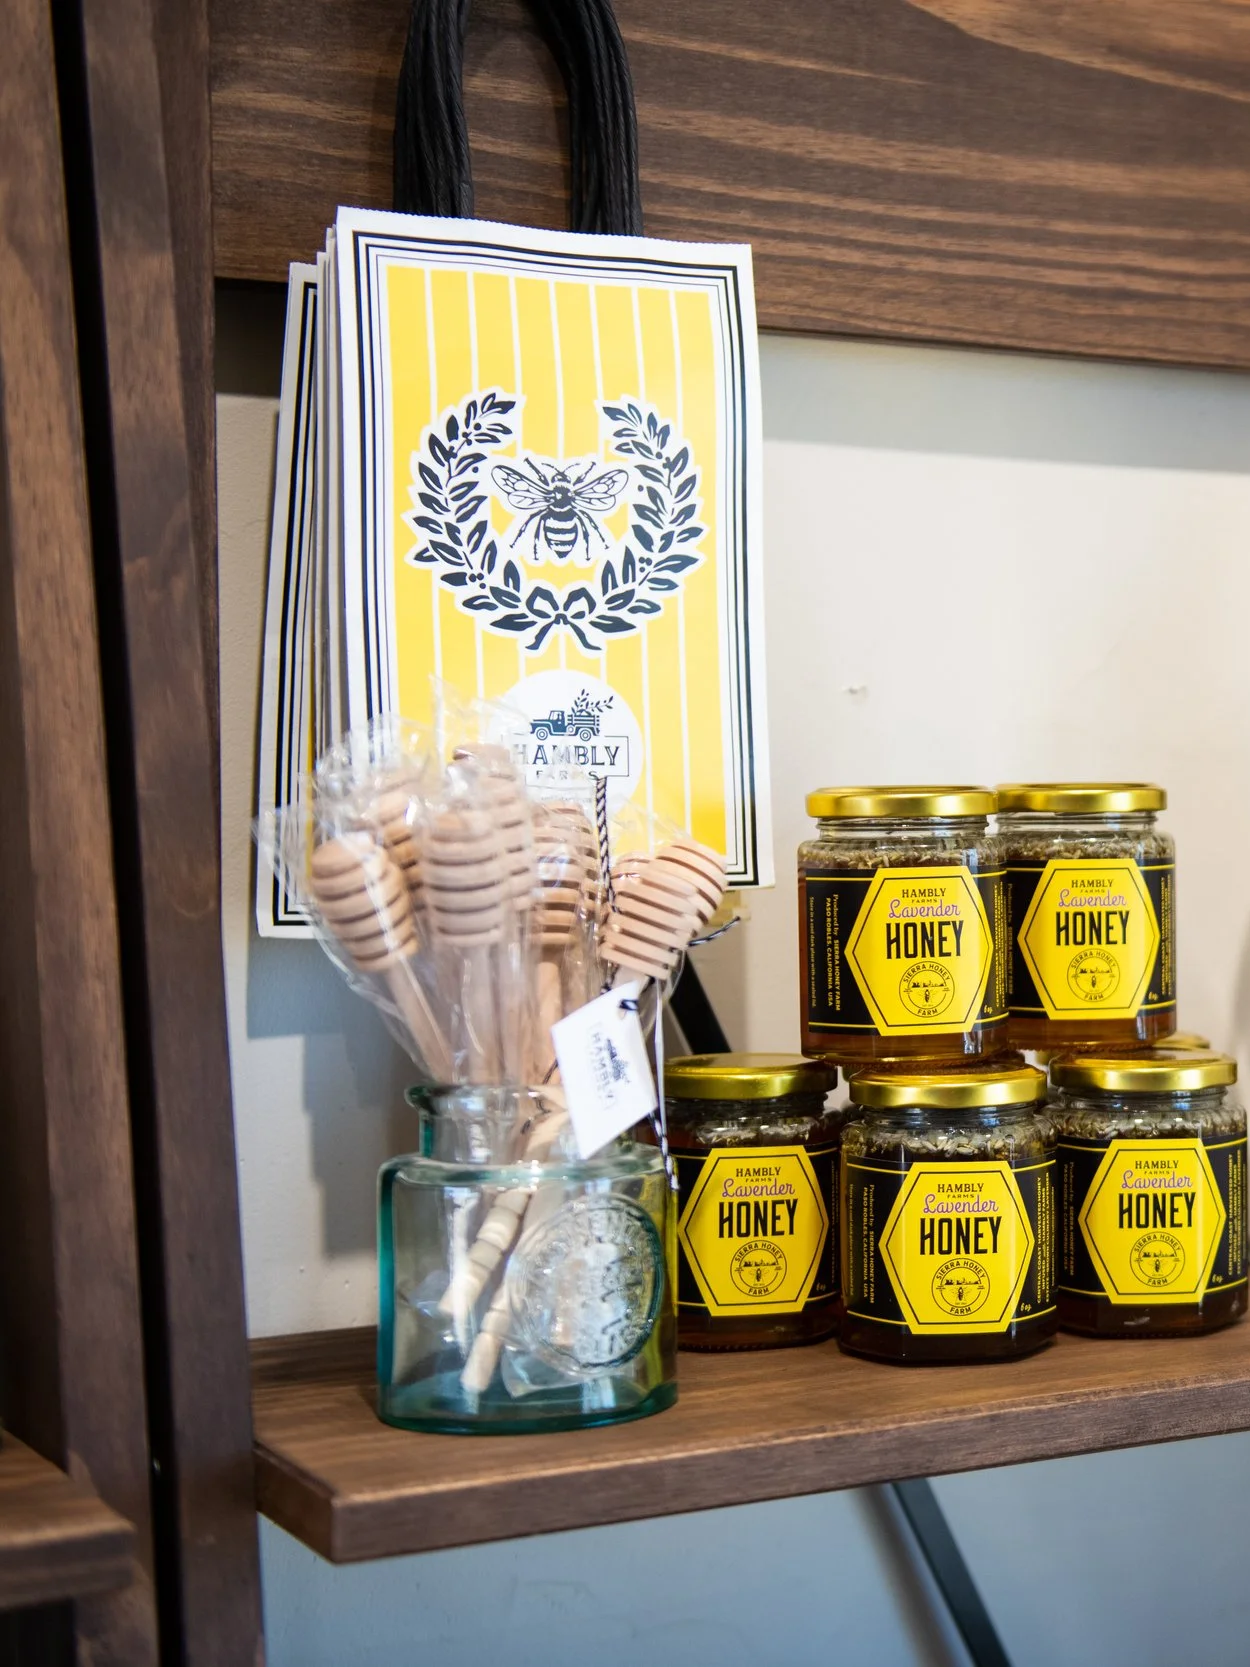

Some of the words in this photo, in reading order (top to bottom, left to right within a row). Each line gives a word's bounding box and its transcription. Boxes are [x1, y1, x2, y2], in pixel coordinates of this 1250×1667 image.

[902, 888, 946, 898] HAMBLY
[1071, 879, 1114, 888] HAMBLY
[1058, 888, 1127, 907] Lavender
[888, 898, 961, 918] Lavender
[833, 927, 838, 936] by
[1056, 911, 1130, 946] HONEY
[886, 920, 964, 959] HONEY
[1071, 951, 1093, 969] SIERRA
[1096, 950, 1116, 967] HONEY
[903, 964, 926, 983] SIERRA
[929, 964, 951, 981] HONEY
[735, 1166, 782, 1177] HAMBLY
[1135, 1160, 1179, 1169] HAMBLY
[722, 1178, 796, 1198] Lavender
[937, 1183, 984, 1193] HAMBLY
[1121, 1169, 1193, 1189] Lavender
[923, 1193, 999, 1214] Lavender
[1118, 1192, 1196, 1229] HONEY
[718, 1198, 798, 1239] HONEY
[868, 1218, 875, 1226] by
[920, 1215, 1002, 1255] HONEY
[1134, 1235, 1157, 1253] SIERRA
[1160, 1235, 1182, 1252] HONEY
[734, 1242, 759, 1262] SIERRA
[761, 1242, 783, 1260] HONEY
[936, 1260, 961, 1279] SIERRA
[963, 1260, 986, 1278] HONEY
[748, 1287, 770, 1296] FARM
[950, 1306, 972, 1314] FARM
